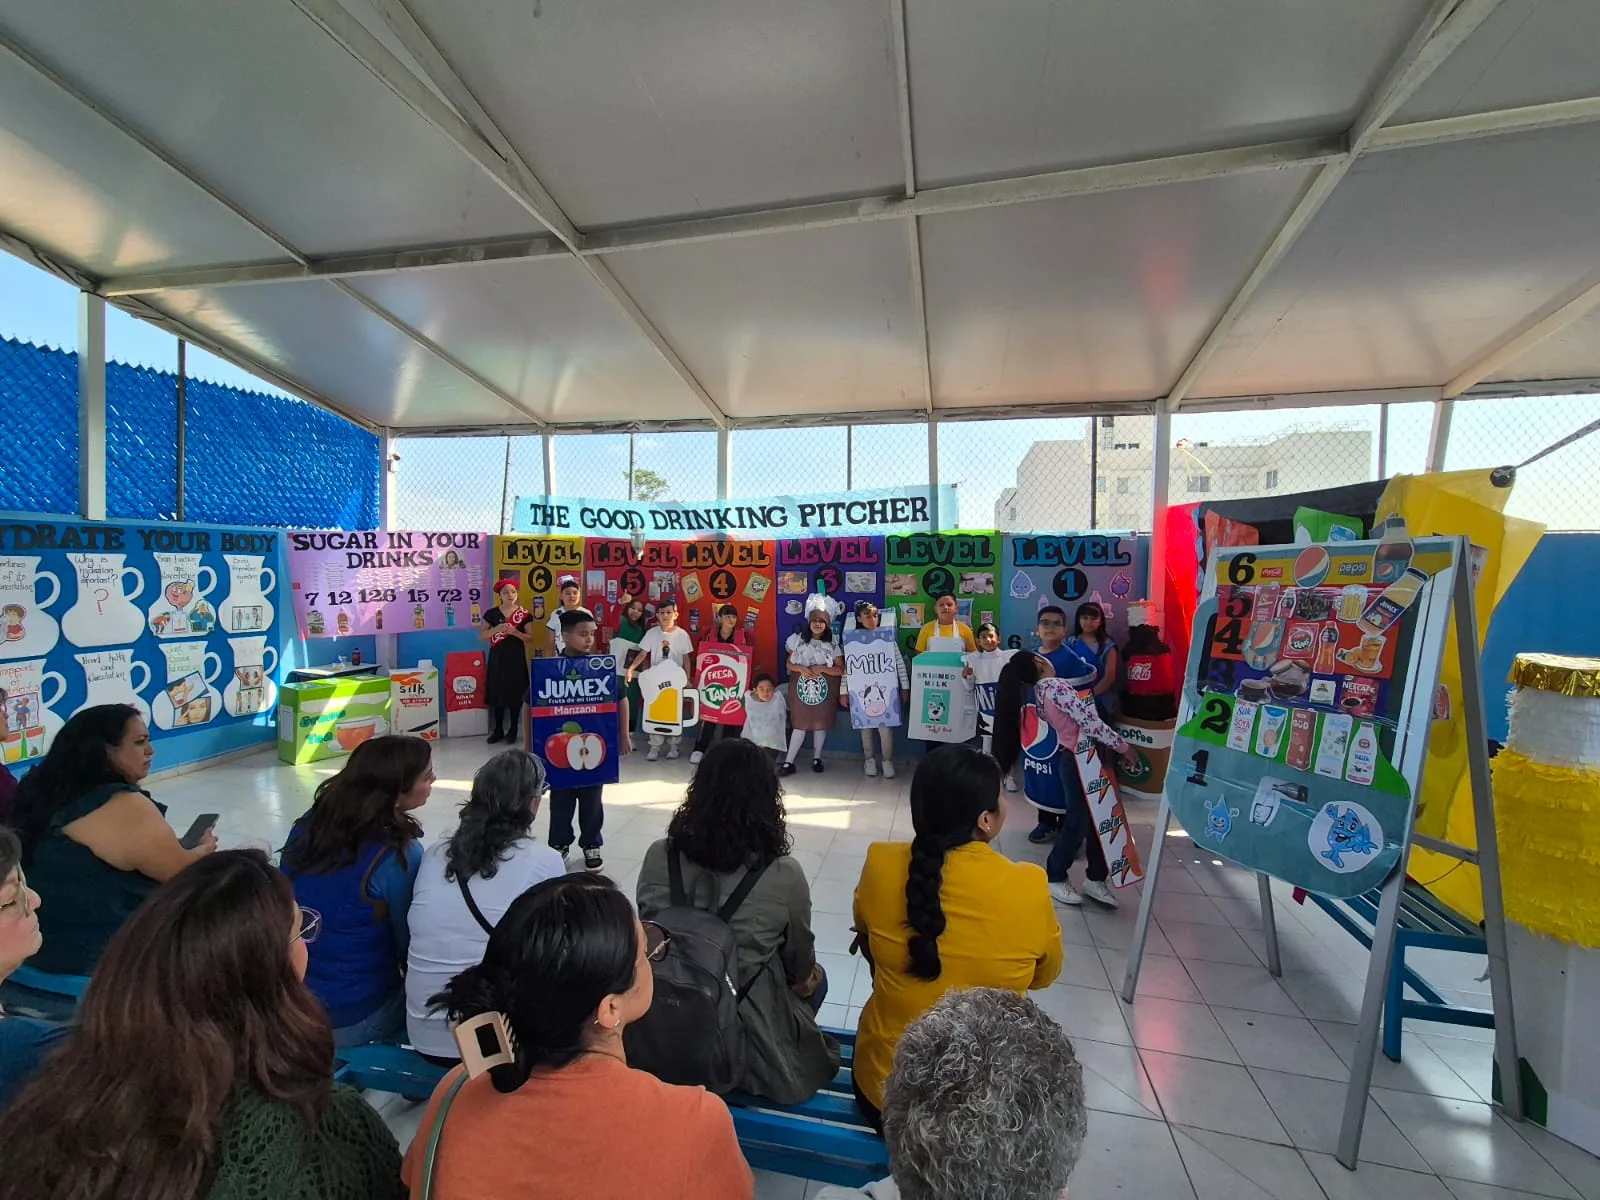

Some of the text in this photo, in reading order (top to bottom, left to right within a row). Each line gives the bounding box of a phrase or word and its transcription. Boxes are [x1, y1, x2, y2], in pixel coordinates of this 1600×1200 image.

[530, 496, 930, 530] THE GOOD DRINKING PITCHER
[138, 530, 213, 552] YOUR
[220, 533, 277, 552] BODY
[293, 532, 480, 551] SUGAR IN YOUR
[501, 539, 582, 566] LEVEL
[780, 535, 879, 565] LEVEL
[886, 533, 996, 566] LEVEL
[1012, 535, 1131, 567] LEVEL
[75, 553, 95, 568] Why
[346, 550, 434, 569] DRINKS
[591, 541, 677, 568] LEVEL
[681, 540, 771, 568] LEVEL
[531, 569, 546, 591] 6
[1228, 552, 1257, 585] 6
[1338, 561, 1367, 575] pepsi
[625, 571, 643, 595] 5
[712, 572, 729, 596] 4
[820, 569, 838, 593] 3
[928, 571, 946, 594] 2
[1060, 571, 1080, 598] 1
[305, 592, 319, 606] 7
[327, 591, 353, 605] 12
[407, 588, 430, 603] 15
[469, 588, 481, 601] 9
[1225, 586, 1251, 618] 5
[1214, 619, 1244, 654] 4
[707, 669, 733, 681] FRESA
[846, 652, 895, 675] Milk
[1211, 658, 1235, 689] 3
[538, 675, 612, 699] JUMEX
[705, 684, 738, 701] TANG
[924, 680, 948, 688] MILK
[554, 705, 597, 715] Manzana
[1201, 698, 1232, 734] 2
[1023, 757, 1053, 775] pepsi
[1186, 750, 1209, 787] 1
